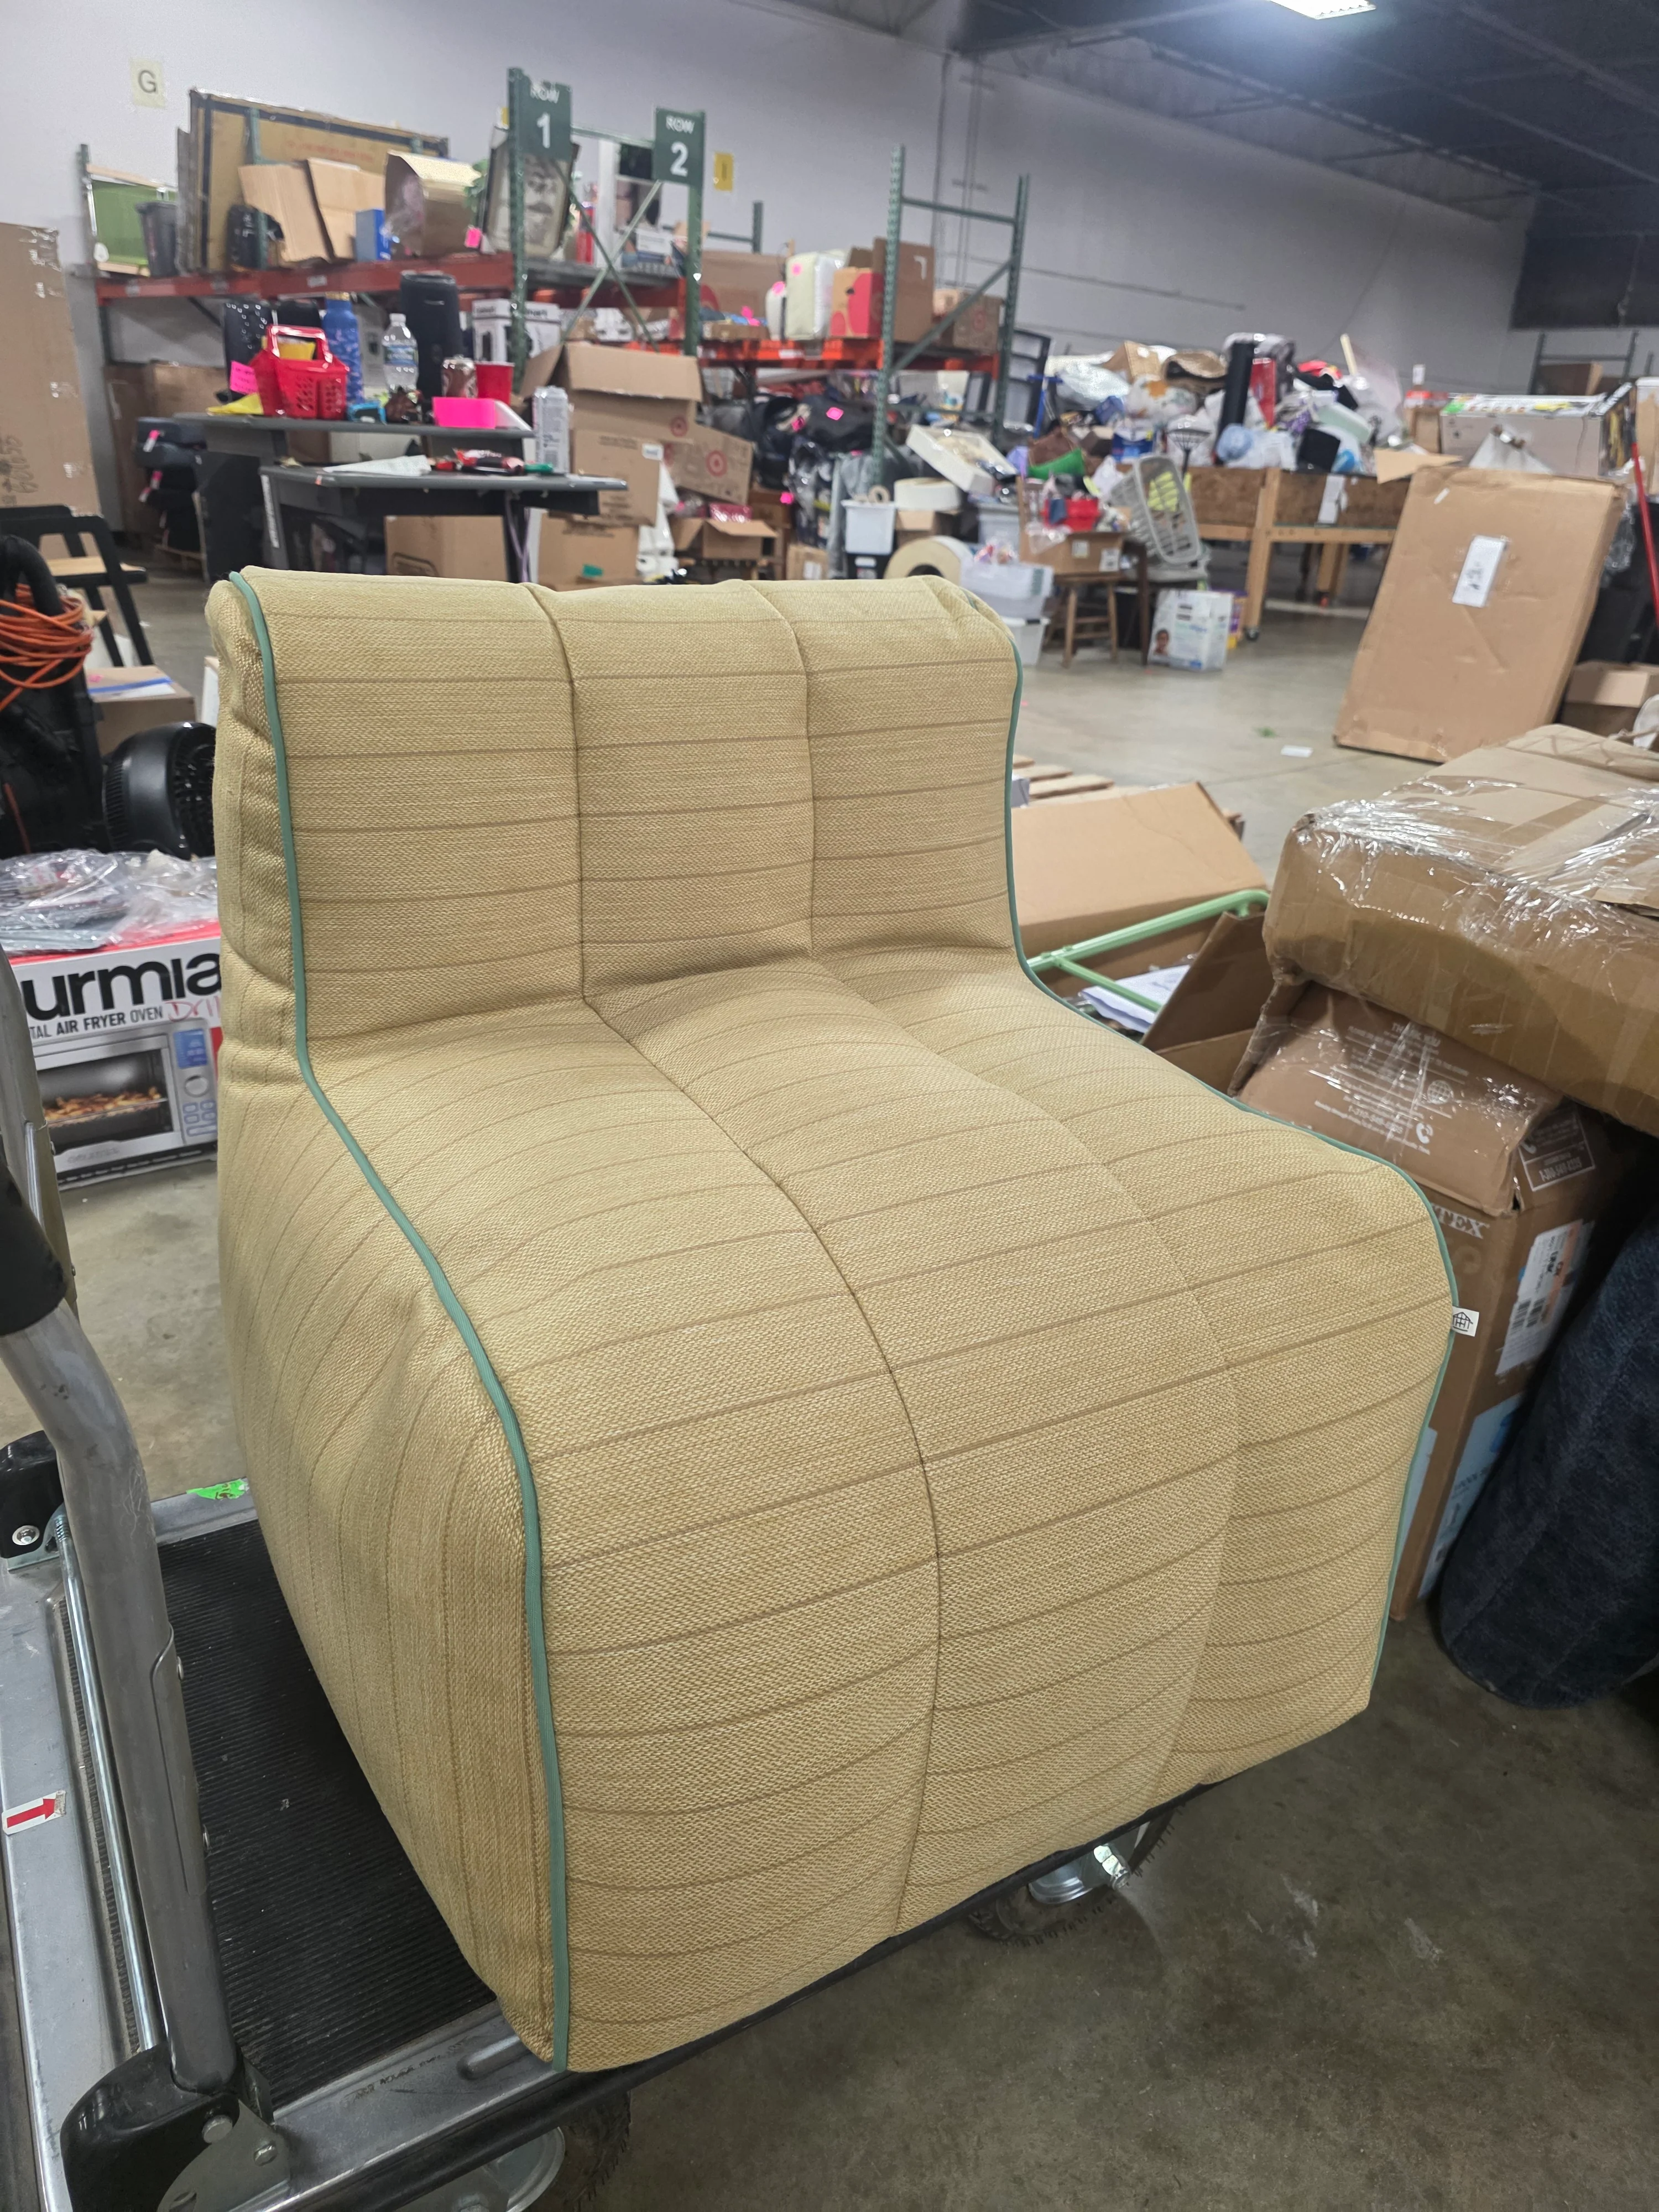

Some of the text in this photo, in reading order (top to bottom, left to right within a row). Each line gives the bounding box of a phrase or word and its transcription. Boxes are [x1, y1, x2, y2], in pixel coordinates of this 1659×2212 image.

[138, 69, 158, 95] G
[530, 82, 560, 104] ROW
[537, 112, 550, 149] 1
[665, 115, 695, 134] ROW
[670, 142, 688, 178] 2
[20, 953, 221, 1021] urmia
[29, 1006, 163, 1040] TAL AIR FRYER OVEN
[1430, 1202, 1491, 1239] TEX
